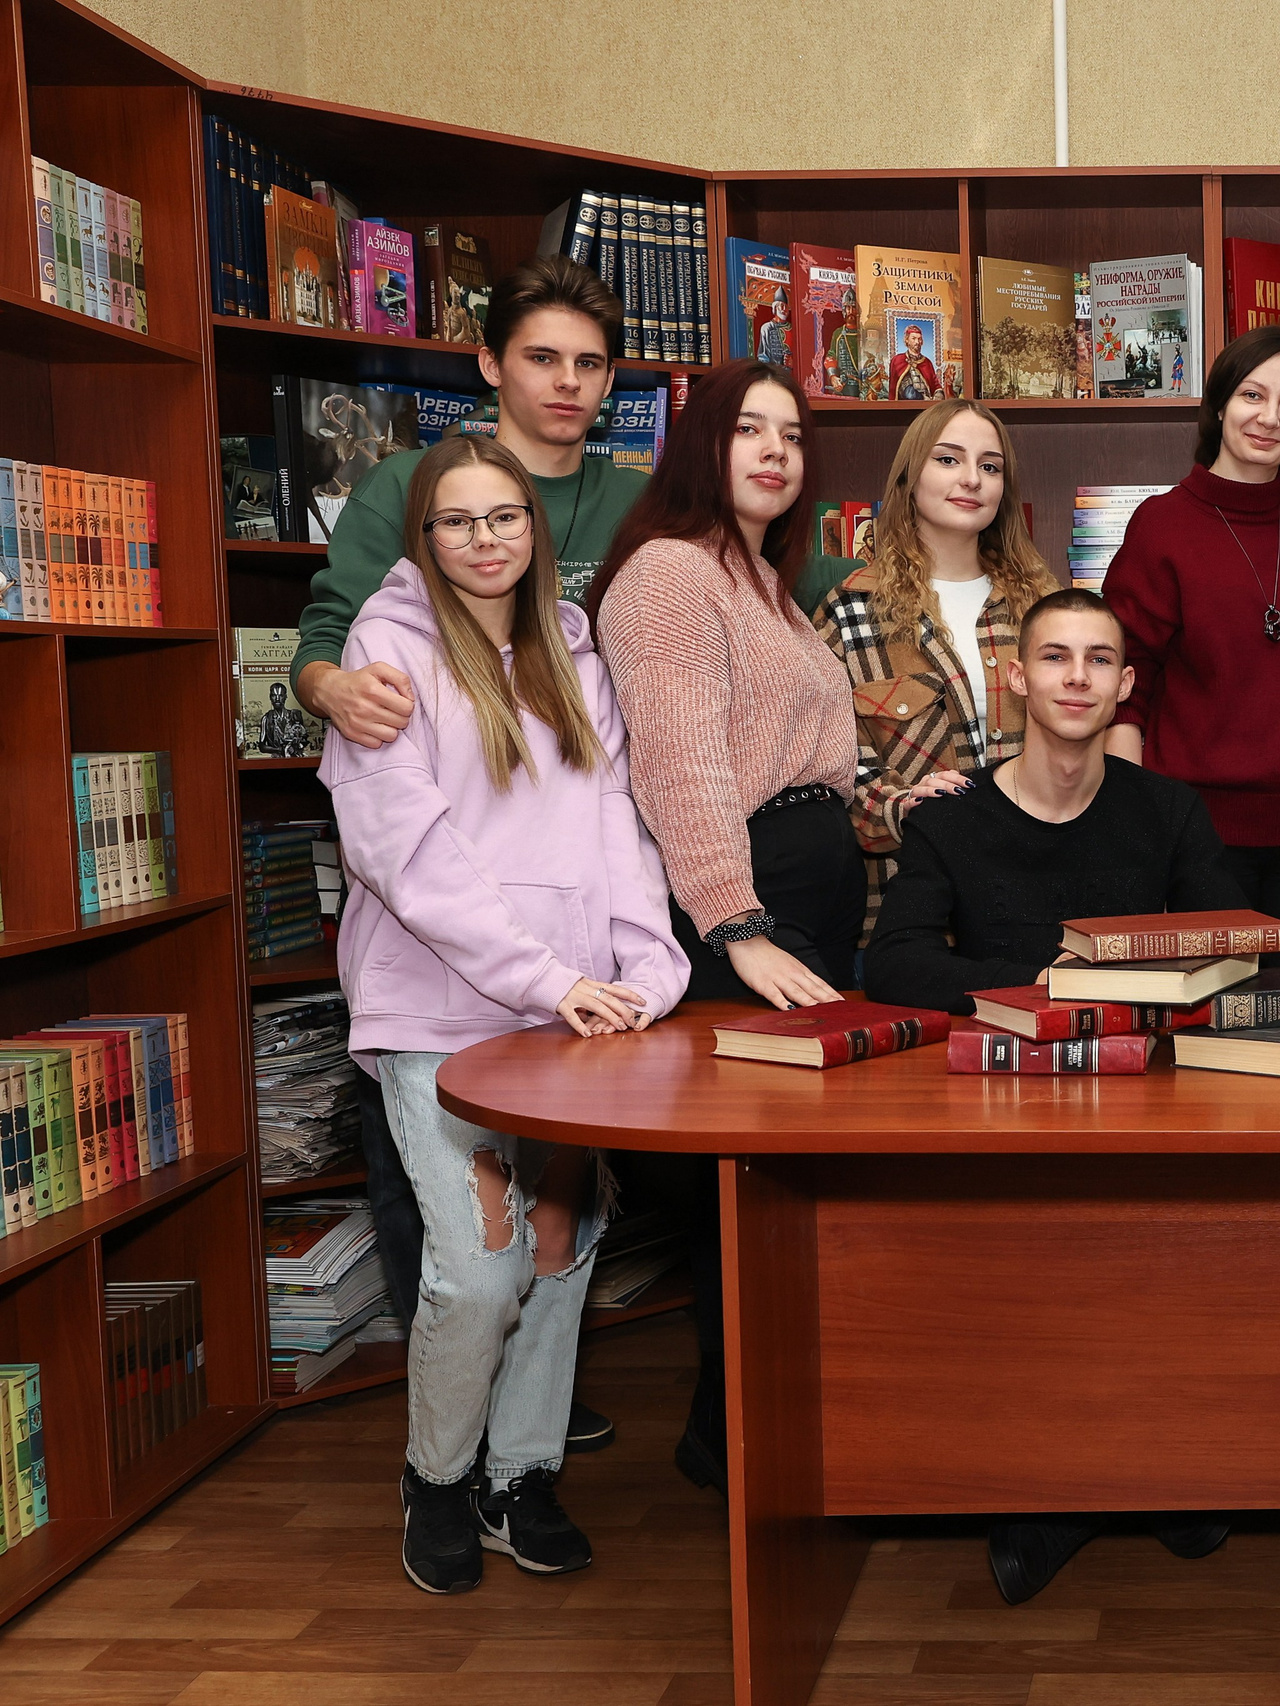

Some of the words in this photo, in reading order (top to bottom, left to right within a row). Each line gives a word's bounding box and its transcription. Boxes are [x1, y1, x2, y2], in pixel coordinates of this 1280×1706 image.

[283, 202, 328, 237] ЗАМКИ
[375, 228, 400, 242] АЙЗЕК
[367, 236, 410, 257] АЗИМОВ
[631, 247, 639, 311] ЭНЦИКЛОПЕДИЯ
[649, 250, 658, 313] ЭНЦИКЛОПЕДИЯ
[665, 252, 675, 315] ЭНЦИКЛОПЕДИЯ
[684, 252, 693, 315] ЭНЦИКЛОПЕДИЯ
[1094, 272, 1147, 286] УНИФОРМА,
[1147, 267, 1186, 282] ОРУЖИЕ,
[894, 281, 933, 293] ЗЕМЛИ
[996, 287, 1061, 300] МЕСТОПРЕБЫВАНИЯ
[1012, 282, 1046, 292] ЛЮБИМЫЕ
[1120, 283, 1161, 297] НАГРАДЫ
[1011, 302, 1048, 312] ГОСУДАРЕЙ
[1014, 296, 1044, 305] РУССКИХ
[1096, 297, 1148, 308] РОССИЙСКОЙ
[1149, 294, 1185, 305] ИМПЕРИИ
[627, 328, 639, 338] 16
[647, 330, 659, 340] 17
[664, 332, 676, 342] 18
[682, 332, 694, 342] 19
[281, 468, 291, 506] ОЛЕНИЙ
[253, 649, 293, 658] ХАГГАР
